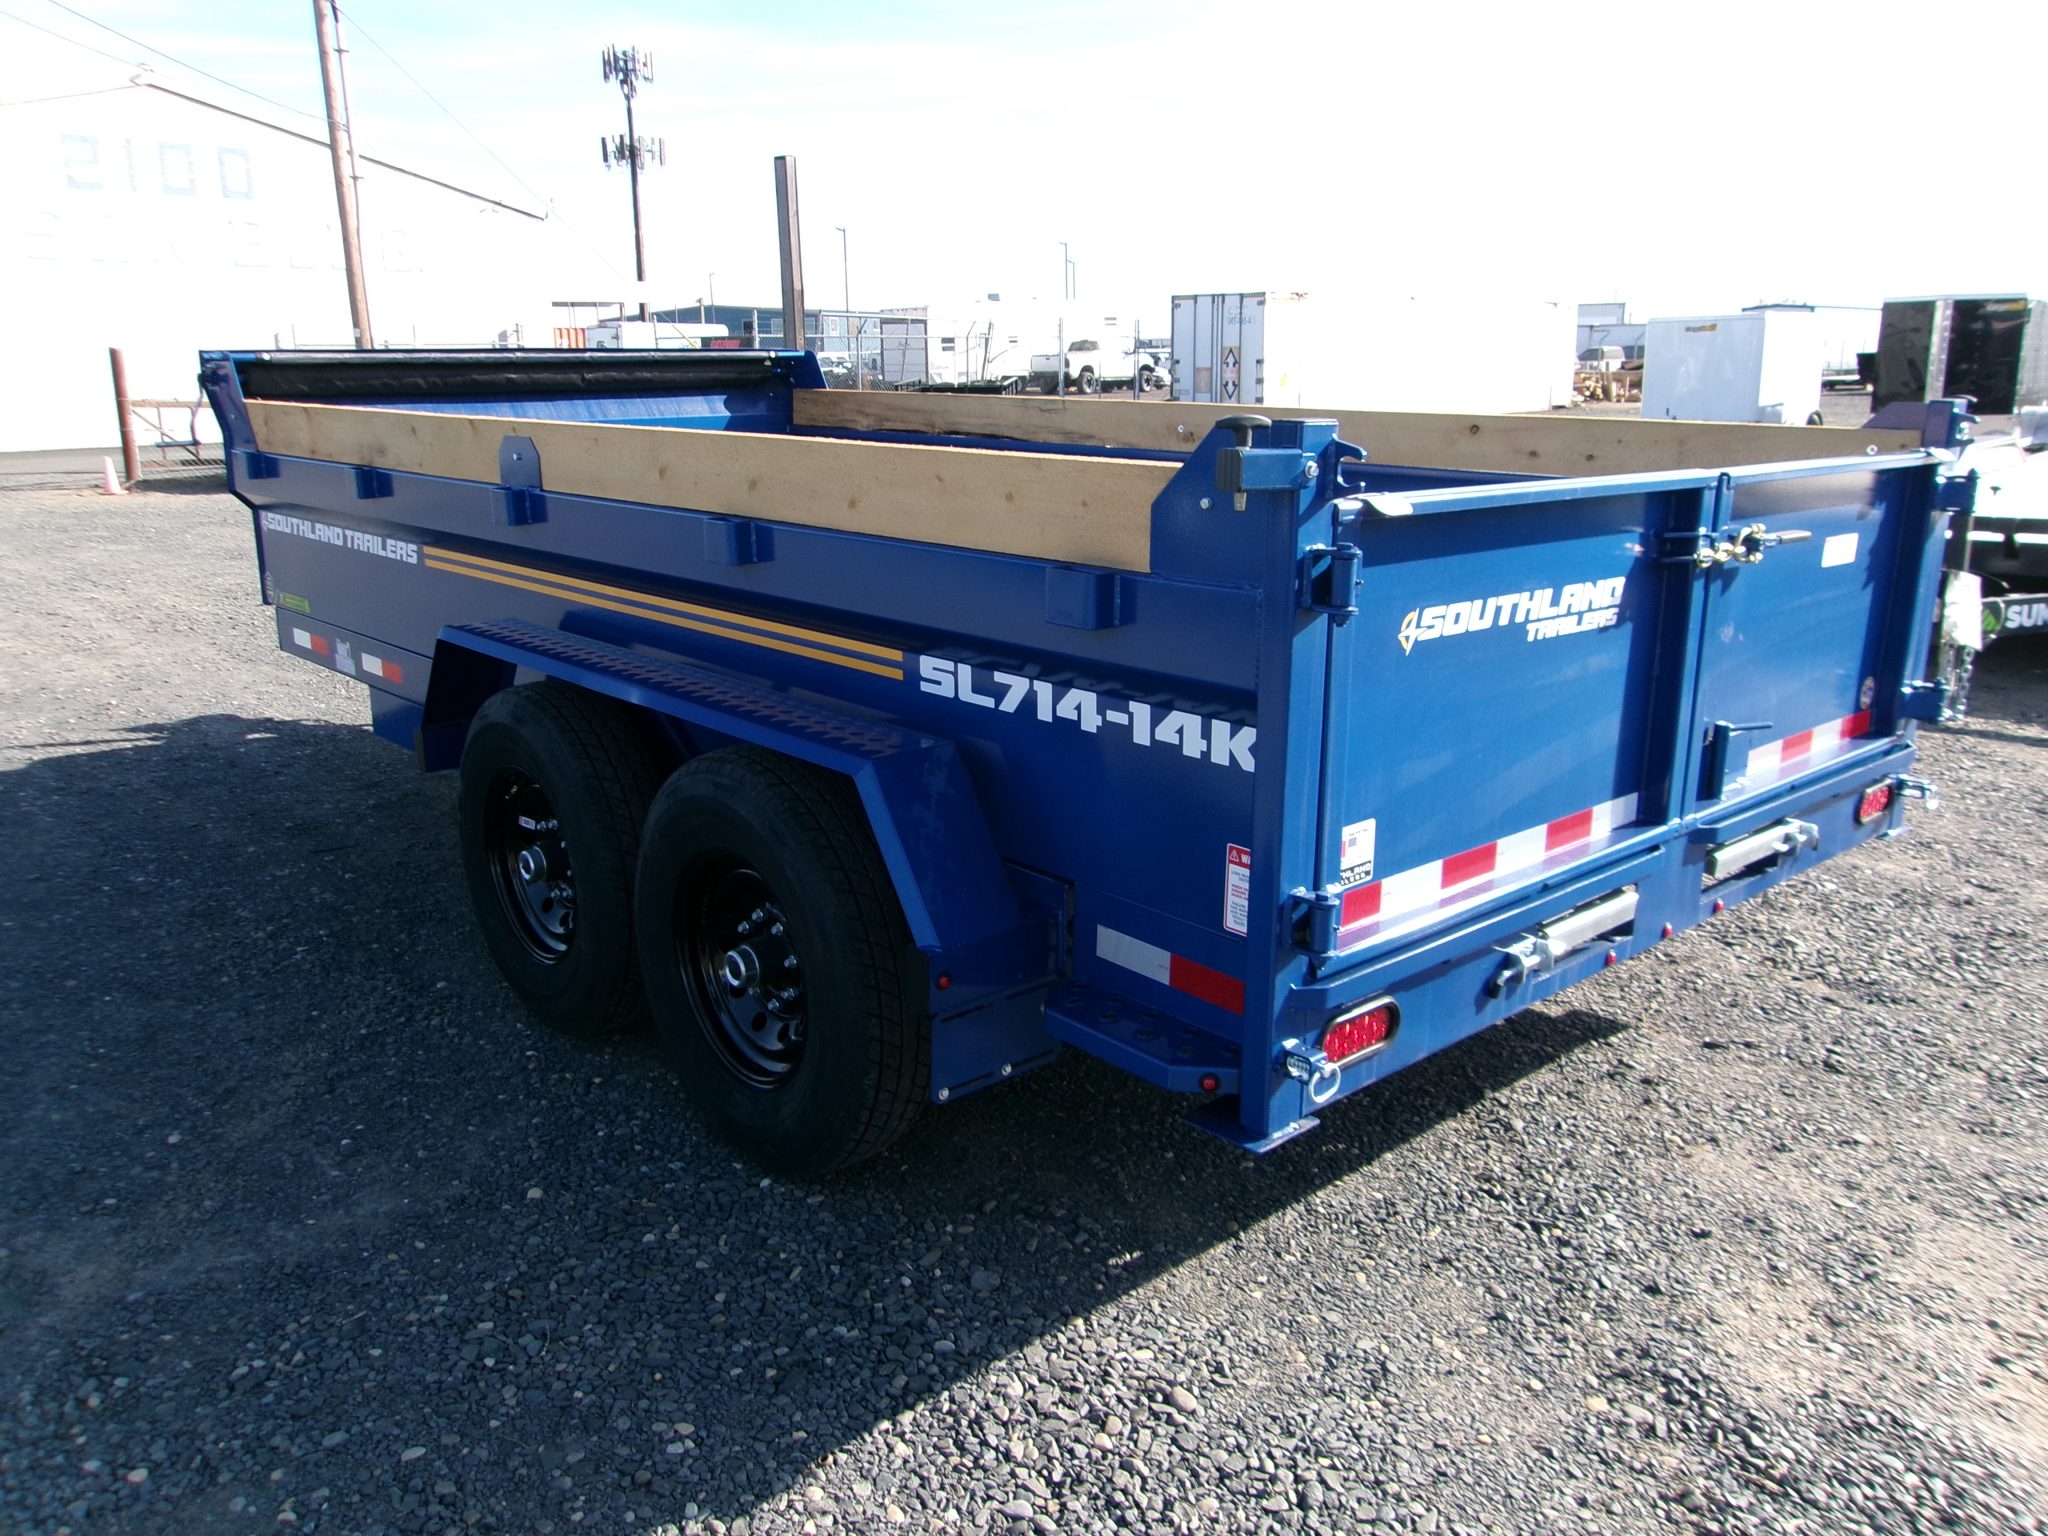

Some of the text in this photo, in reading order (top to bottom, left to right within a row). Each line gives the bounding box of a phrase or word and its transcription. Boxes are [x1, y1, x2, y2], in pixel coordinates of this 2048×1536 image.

[60, 134, 255, 199] 2100
[267, 512, 418, 565] SOUTHLAND TRAILERS
[1417, 576, 1626, 641] SOUTHLAND
[1526, 608, 1619, 642] TRAILERS
[919, 654, 1257, 773] SL714-14K
